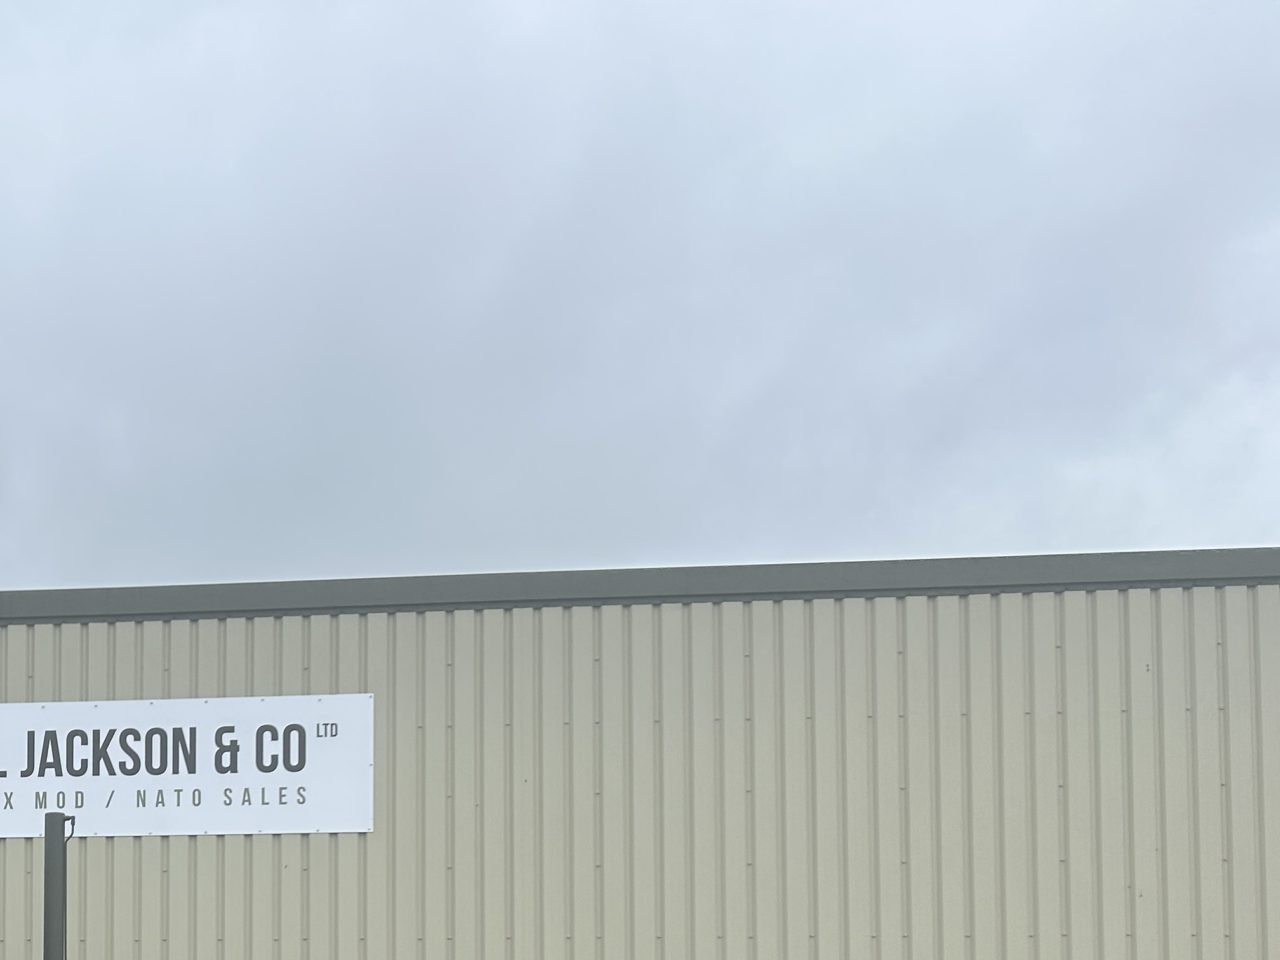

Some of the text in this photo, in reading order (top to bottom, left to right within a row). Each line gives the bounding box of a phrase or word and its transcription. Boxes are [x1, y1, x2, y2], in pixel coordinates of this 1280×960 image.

[20, 726, 197, 778] JACKSON
[214, 725, 240, 774] &
[255, 723, 307, 774] CO
[316, 722, 339, 739] LTD
[35, 790, 85, 810] MOD
[136, 788, 202, 808] NATO
[223, 786, 307, 806] SALES
